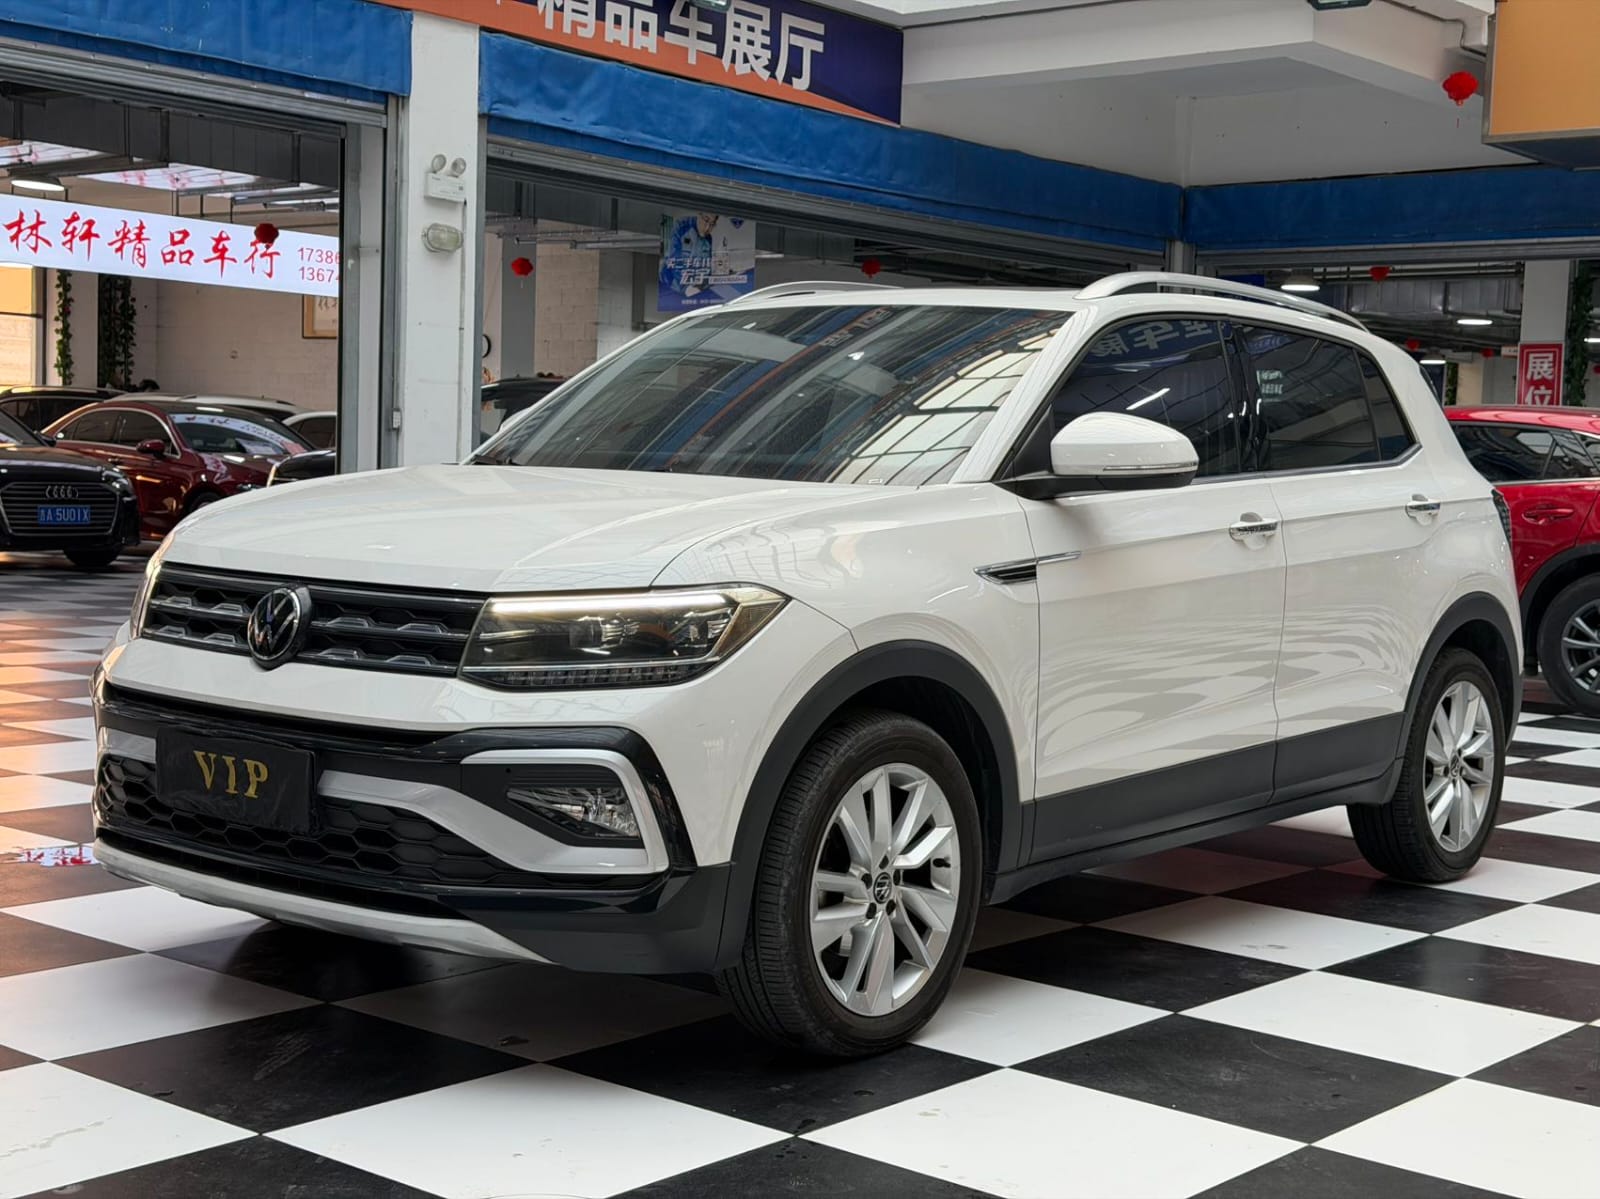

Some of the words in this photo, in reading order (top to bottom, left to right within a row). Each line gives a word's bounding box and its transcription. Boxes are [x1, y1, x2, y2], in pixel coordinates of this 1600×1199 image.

[2, 209, 282, 280] 林轩精品车行
[1524, 352, 1554, 406] 展位
[194, 750, 269, 800] VIP
